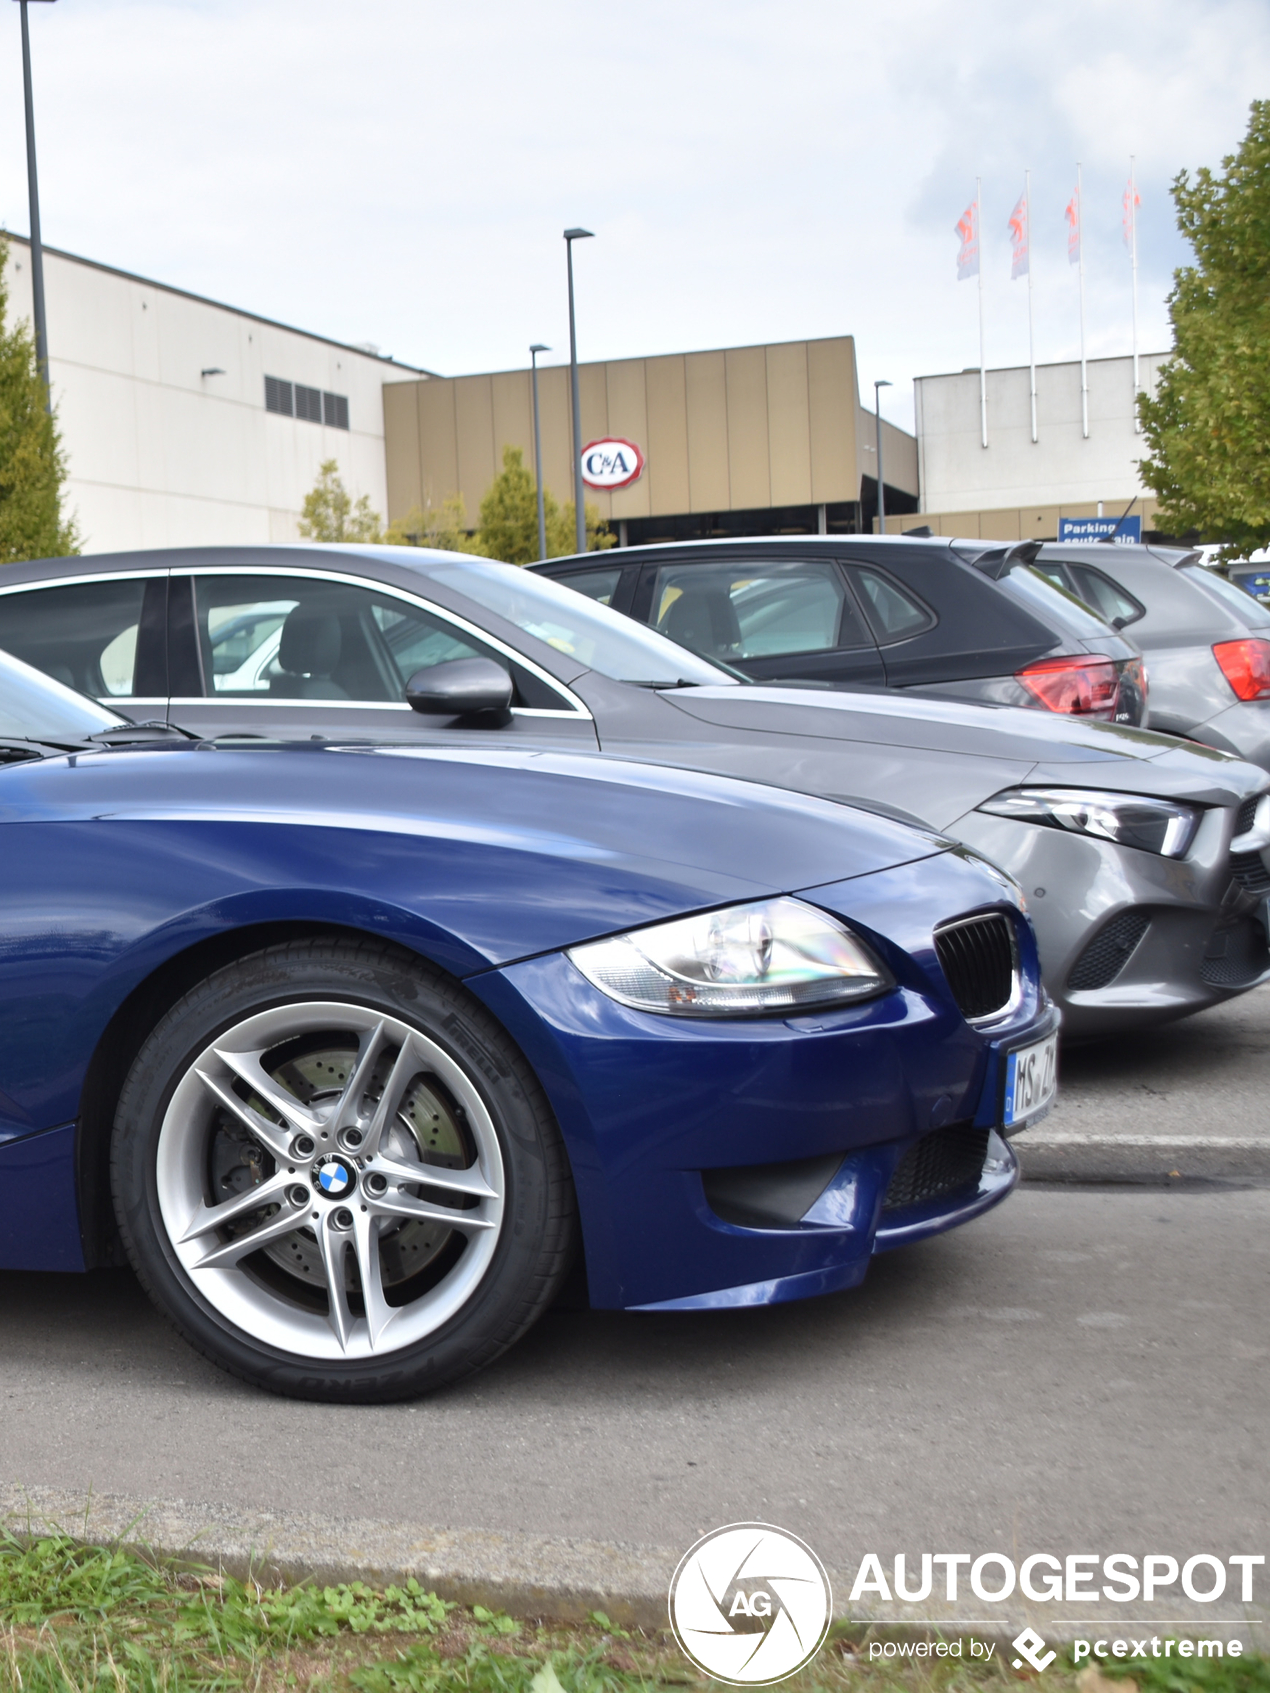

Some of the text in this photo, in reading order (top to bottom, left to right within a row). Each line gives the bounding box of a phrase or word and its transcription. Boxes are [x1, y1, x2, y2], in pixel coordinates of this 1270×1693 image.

[586, 450, 630, 475] C&A
[1063, 522, 1116, 535] Parking
[312, 1154, 333, 1191] BMW
